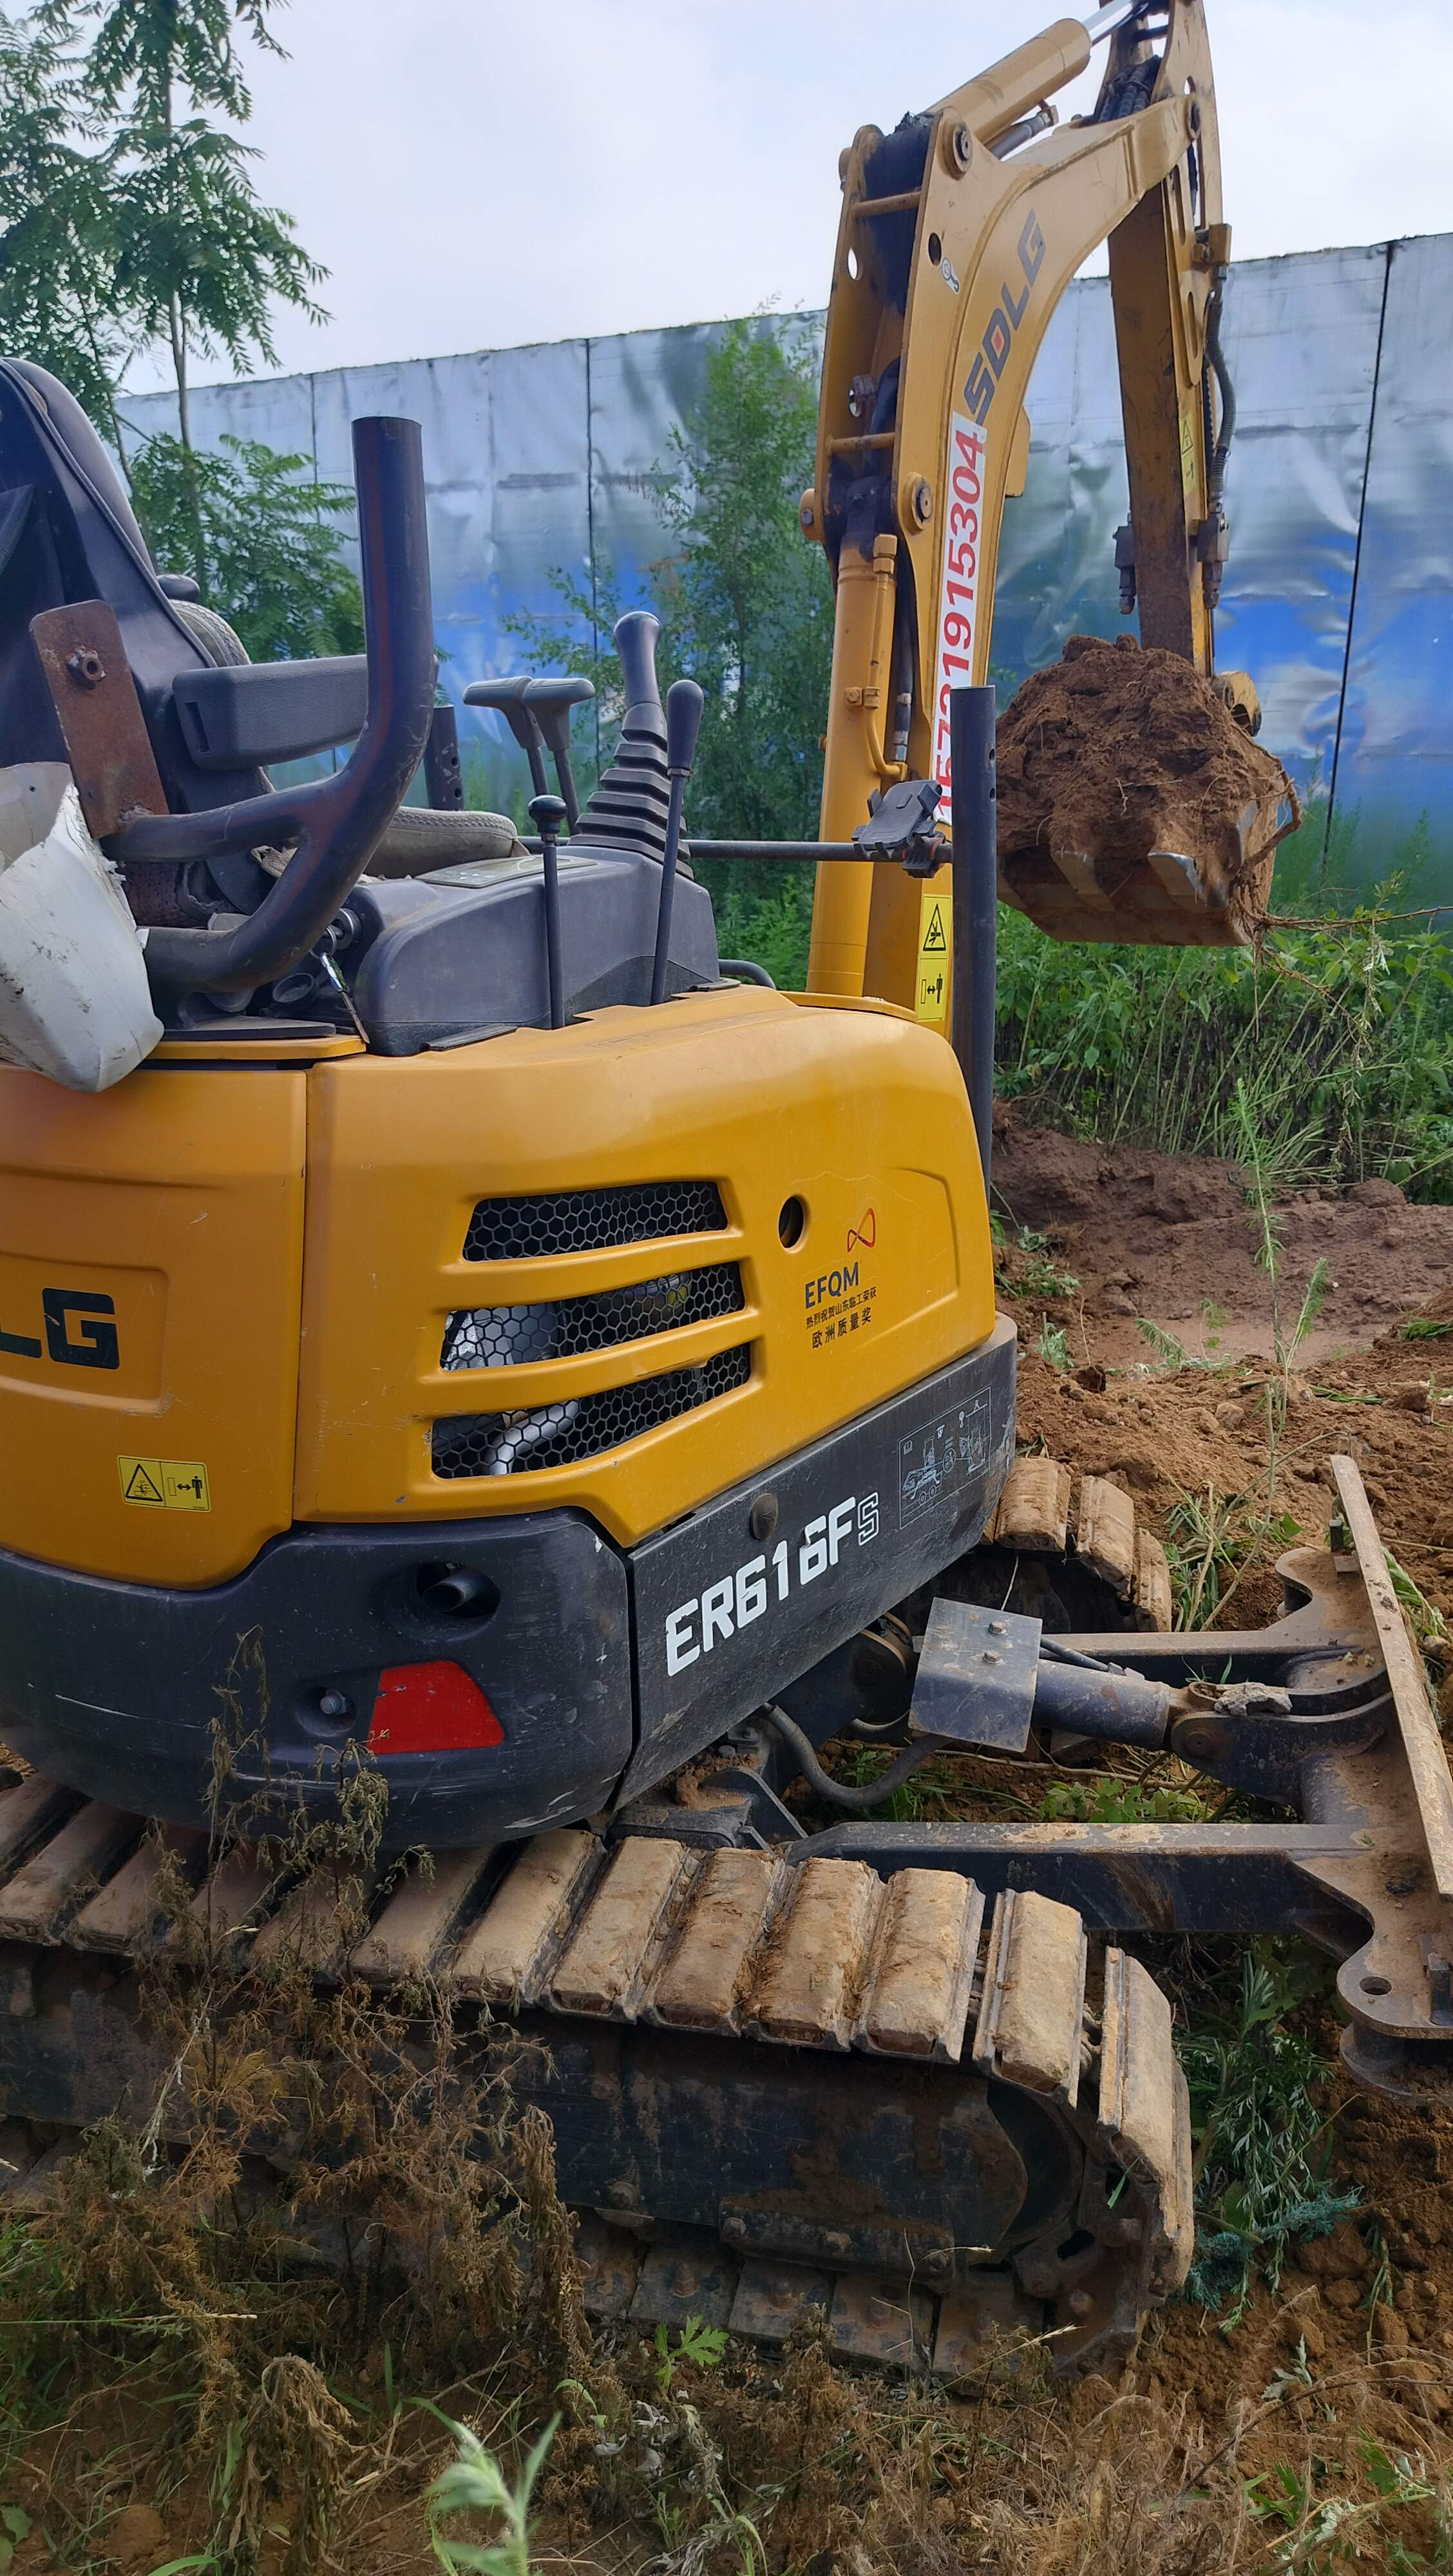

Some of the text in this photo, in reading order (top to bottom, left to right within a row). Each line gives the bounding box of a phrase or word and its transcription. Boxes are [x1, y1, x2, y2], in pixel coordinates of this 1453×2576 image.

[964, 209, 1046, 428] SDLG
[805, 1261, 860, 1309] EFQM
[806, 1286, 877, 1330] 热烈祝贺山东临工荣获
[812, 1307, 872, 1349] 欧洲质量奖
